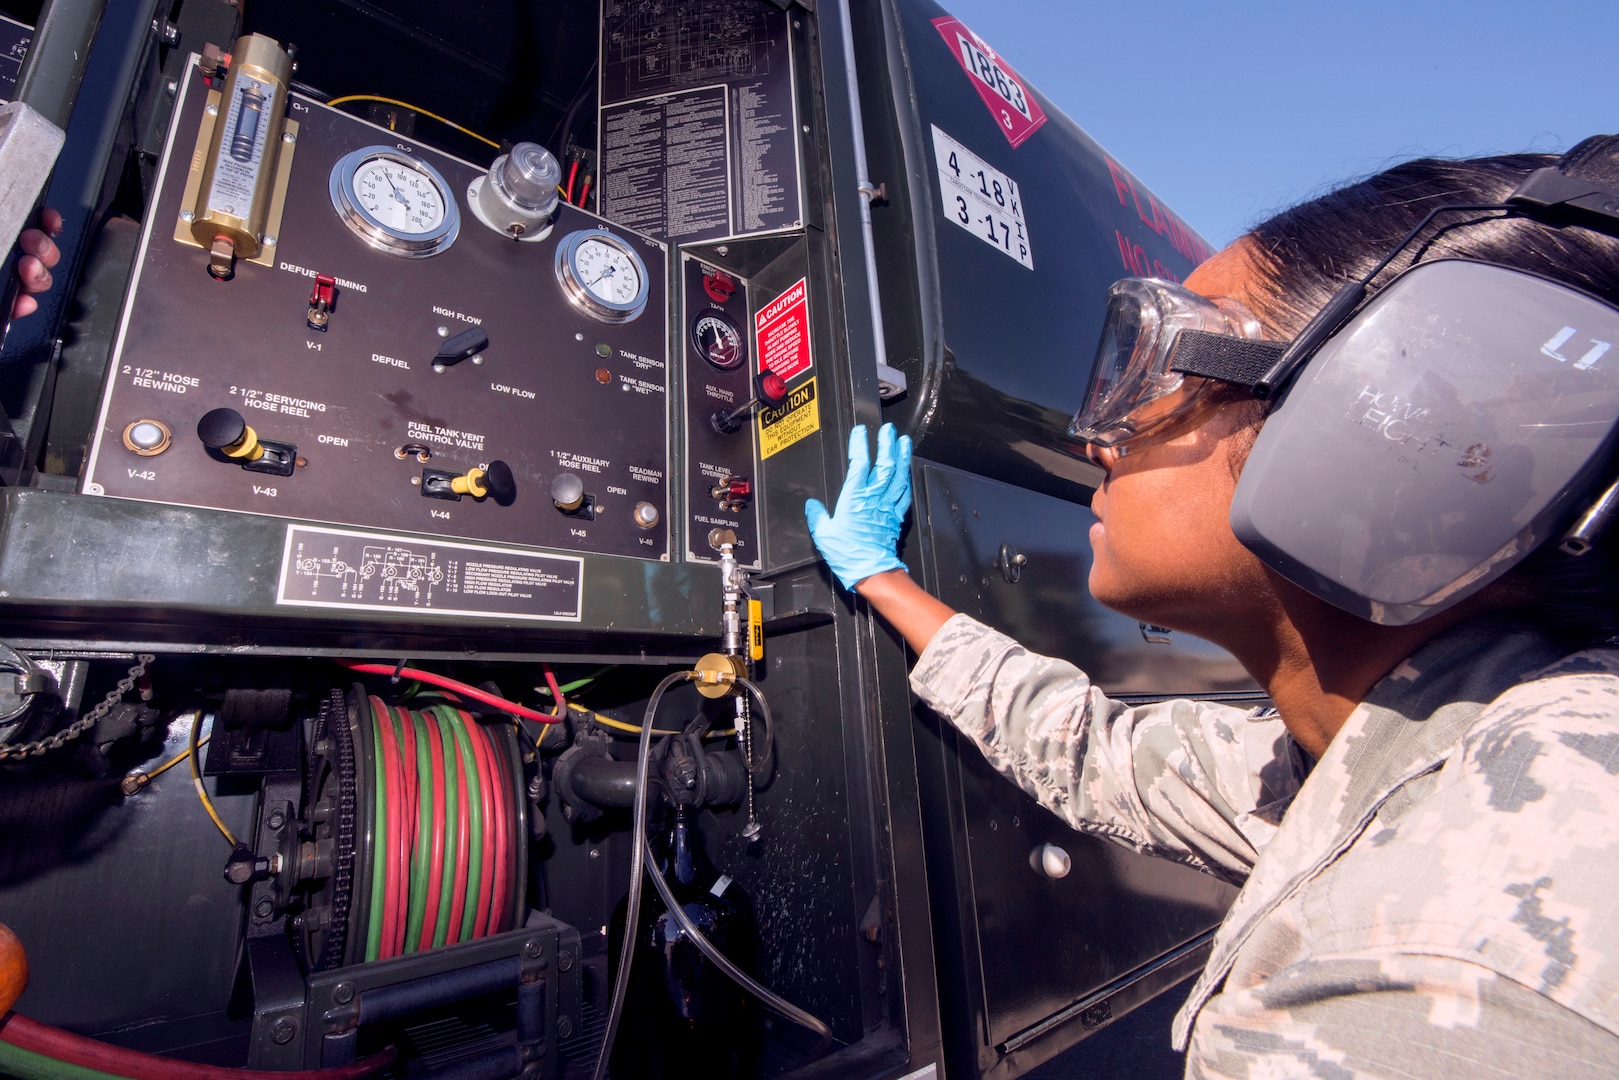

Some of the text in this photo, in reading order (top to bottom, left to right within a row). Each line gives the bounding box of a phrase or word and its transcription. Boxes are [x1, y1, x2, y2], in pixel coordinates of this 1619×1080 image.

[962, 40, 1026, 114] 1863
[292, 102, 309, 114] G-1
[1001, 109, 1013, 130] 3
[948, 152, 960, 178] 4
[410, 180, 418, 188] 120
[1006, 178, 1014, 195] V
[417, 190, 426, 198] 140
[956, 195, 970, 224] 3
[1010, 198, 1020, 218] K
[1020, 244, 1026, 260] P
[1115, 230, 1152, 279] NO
[280, 262, 320, 278] DEFUE
[766, 286, 802, 319] CAUTION
[432, 306, 482, 326] HIGH FLOW
[786, 316, 794, 324] THE
[764, 319, 800, 346] THROTTLE SLOWLY
[772, 340, 780, 348] ANY
[780, 327, 798, 342] PUMPING
[306, 341, 322, 351] V-1
[765, 331, 801, 359] MODE AND REDUCE
[766, 338, 802, 364] THE ENGINE SPEED
[783, 346, 799, 360] BEFORE
[372, 354, 410, 370] DEFUEL
[620, 350, 664, 368] TANK SENSOR
[633, 360, 652, 370] "DRY"
[771, 353, 798, 373] HANGING THE
[122, 365, 132, 374] 2
[162, 372, 200, 387] HOSE
[620, 374, 664, 392] TANK SENSOR
[132, 376, 186, 394] REWIND
[491, 382, 536, 400] LOW FLOW
[632, 385, 652, 395] "WET"
[706, 384, 734, 398] AUX. HAND
[230, 386, 238, 394] 2
[265, 392, 326, 412] SERVICING
[706, 390, 734, 402] THROTTLE
[244, 398, 310, 418] HOSE REEL
[765, 388, 808, 424] CAUTION
[774, 420, 785, 429] NOT
[786, 404, 812, 422] OPERATE
[408, 422, 485, 442] FUEL TANK VENT
[767, 411, 811, 440] THIS EQUIPMENT
[778, 424, 801, 441] WITHOUT
[318, 434, 348, 447] OPEN
[408, 430, 484, 451] CONTROL VALVE
[766, 423, 814, 454] EAR PROTECTION
[560, 459, 602, 474] HOSE REEL
[572, 454, 610, 468] AUXILIARY
[699, 462, 732, 475] TANK LEVEL
[128, 468, 156, 480] V-42
[630, 466, 662, 478] DEADMAN
[632, 473, 660, 484] REWIND
[702, 469, 730, 480] OVERRIDE
[252, 486, 278, 497] V-43
[606, 486, 627, 496] OPEN
[430, 510, 450, 520] V-44
[694, 515, 738, 528] FUEL SAMPLING
[570, 529, 586, 537] V-45
